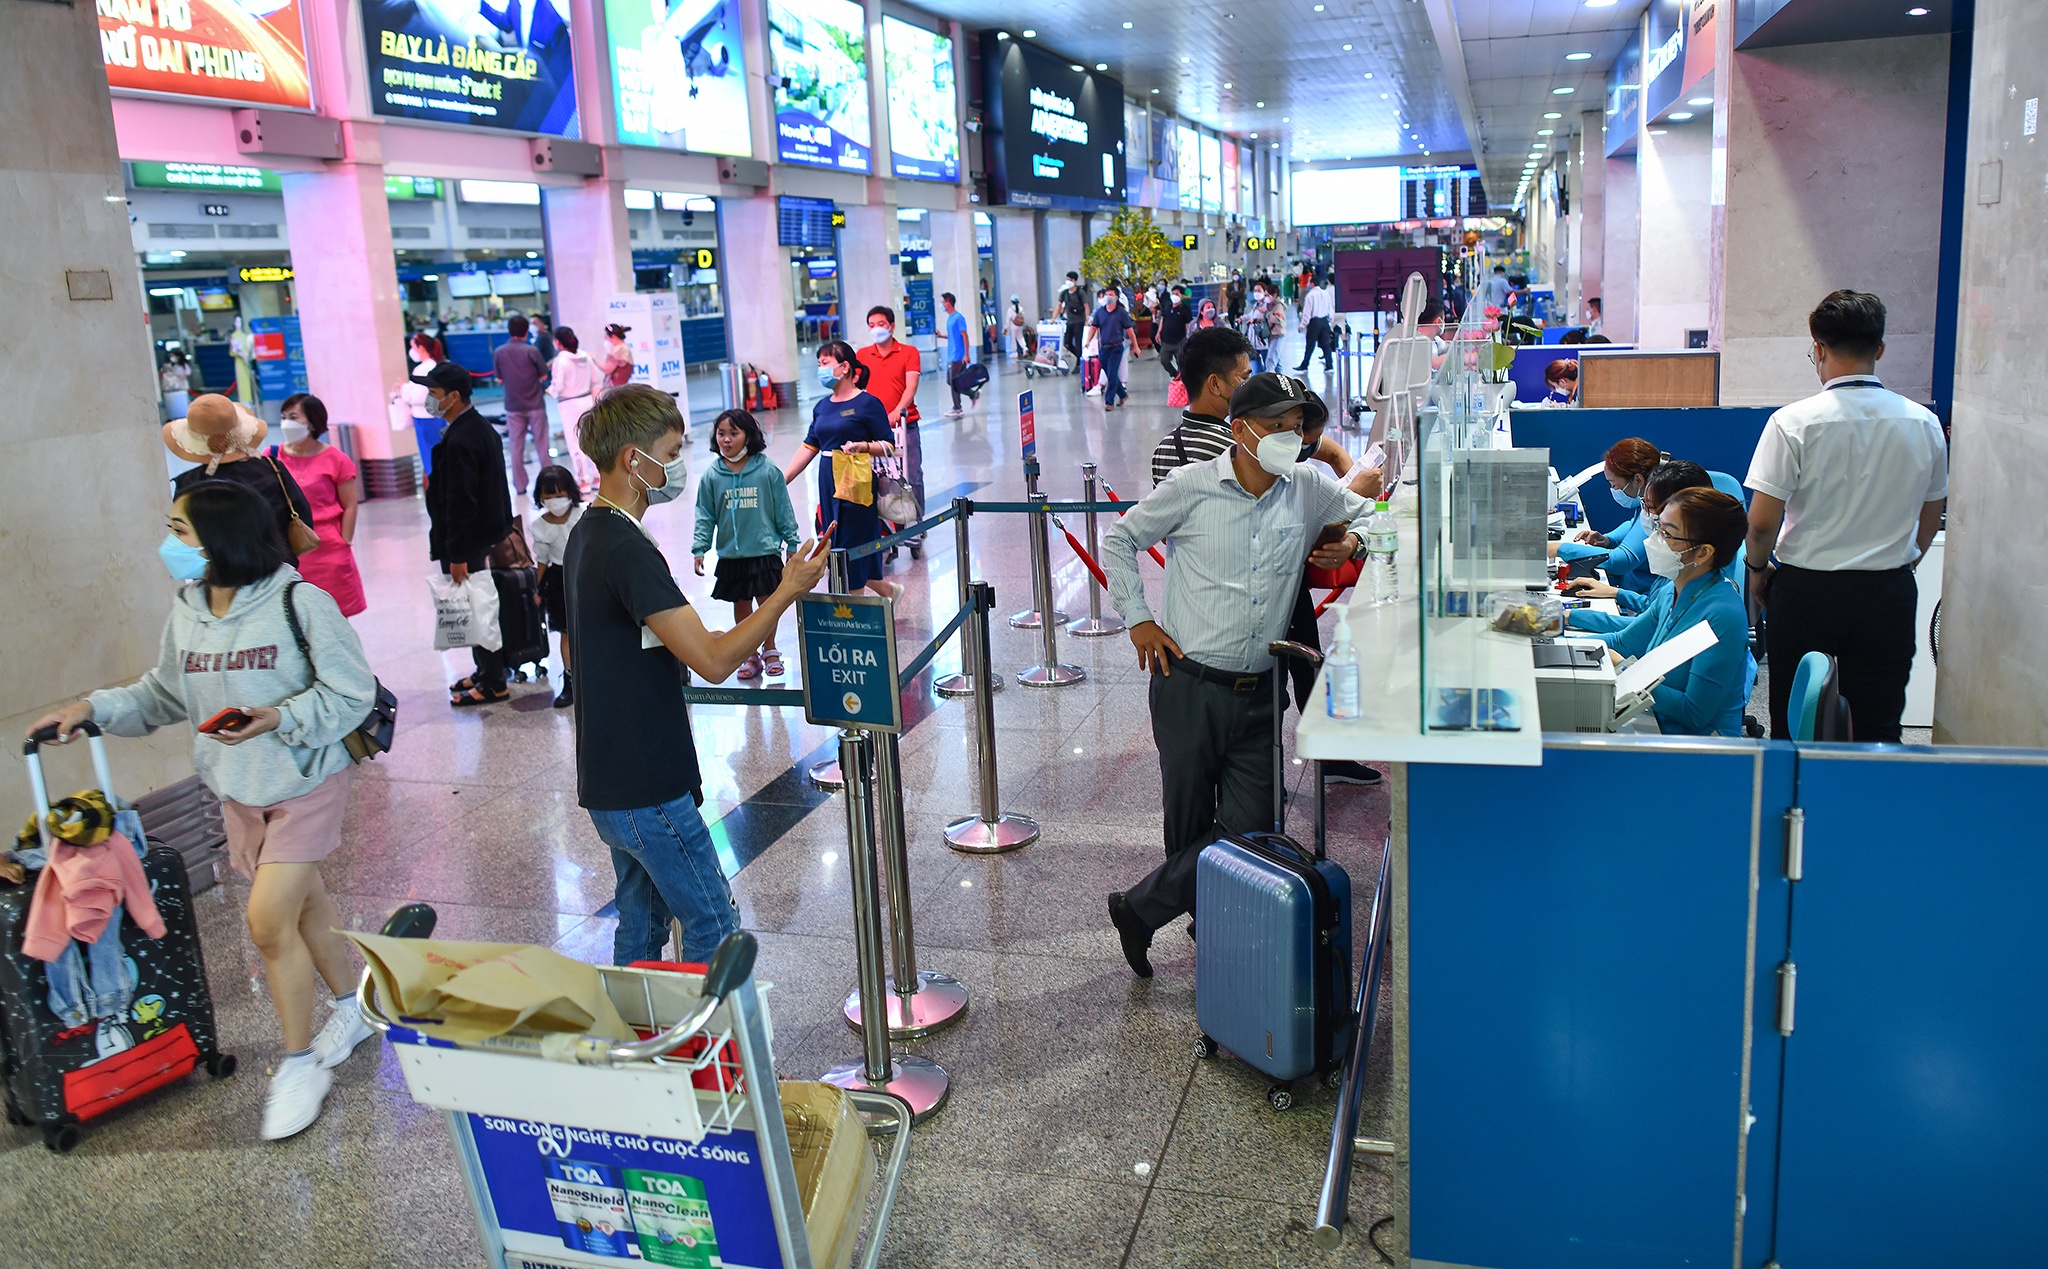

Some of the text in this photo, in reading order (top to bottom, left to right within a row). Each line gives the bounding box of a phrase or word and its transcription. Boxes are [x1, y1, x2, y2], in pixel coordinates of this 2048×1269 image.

[381, 30, 422, 62] BAY
[425, 34, 449, 65] LÀ
[184, 41, 266, 82] PHONG
[1185, 235, 1196, 250] F
[1248, 238, 1259, 250] G
[1265, 238, 1276, 250] H
[698, 249, 713, 268] D
[610, 301, 627, 309] ACV
[653, 299, 664, 307] ACV
[632, 364, 650, 375] TM
[661, 360, 680, 373] ATM
[818, 643, 878, 667] LỐI RA
[832, 669, 867, 685] EXIT
[484, 1117, 750, 1165] SƠN CÔNG NGHỆ CHO CUỘC SỐNG
[560, 1164, 605, 1185] TOA
[550, 1184, 625, 1206] NanoShield
[641, 1176, 688, 1197] TOA
[631, 1195, 709, 1218] NanoClean
